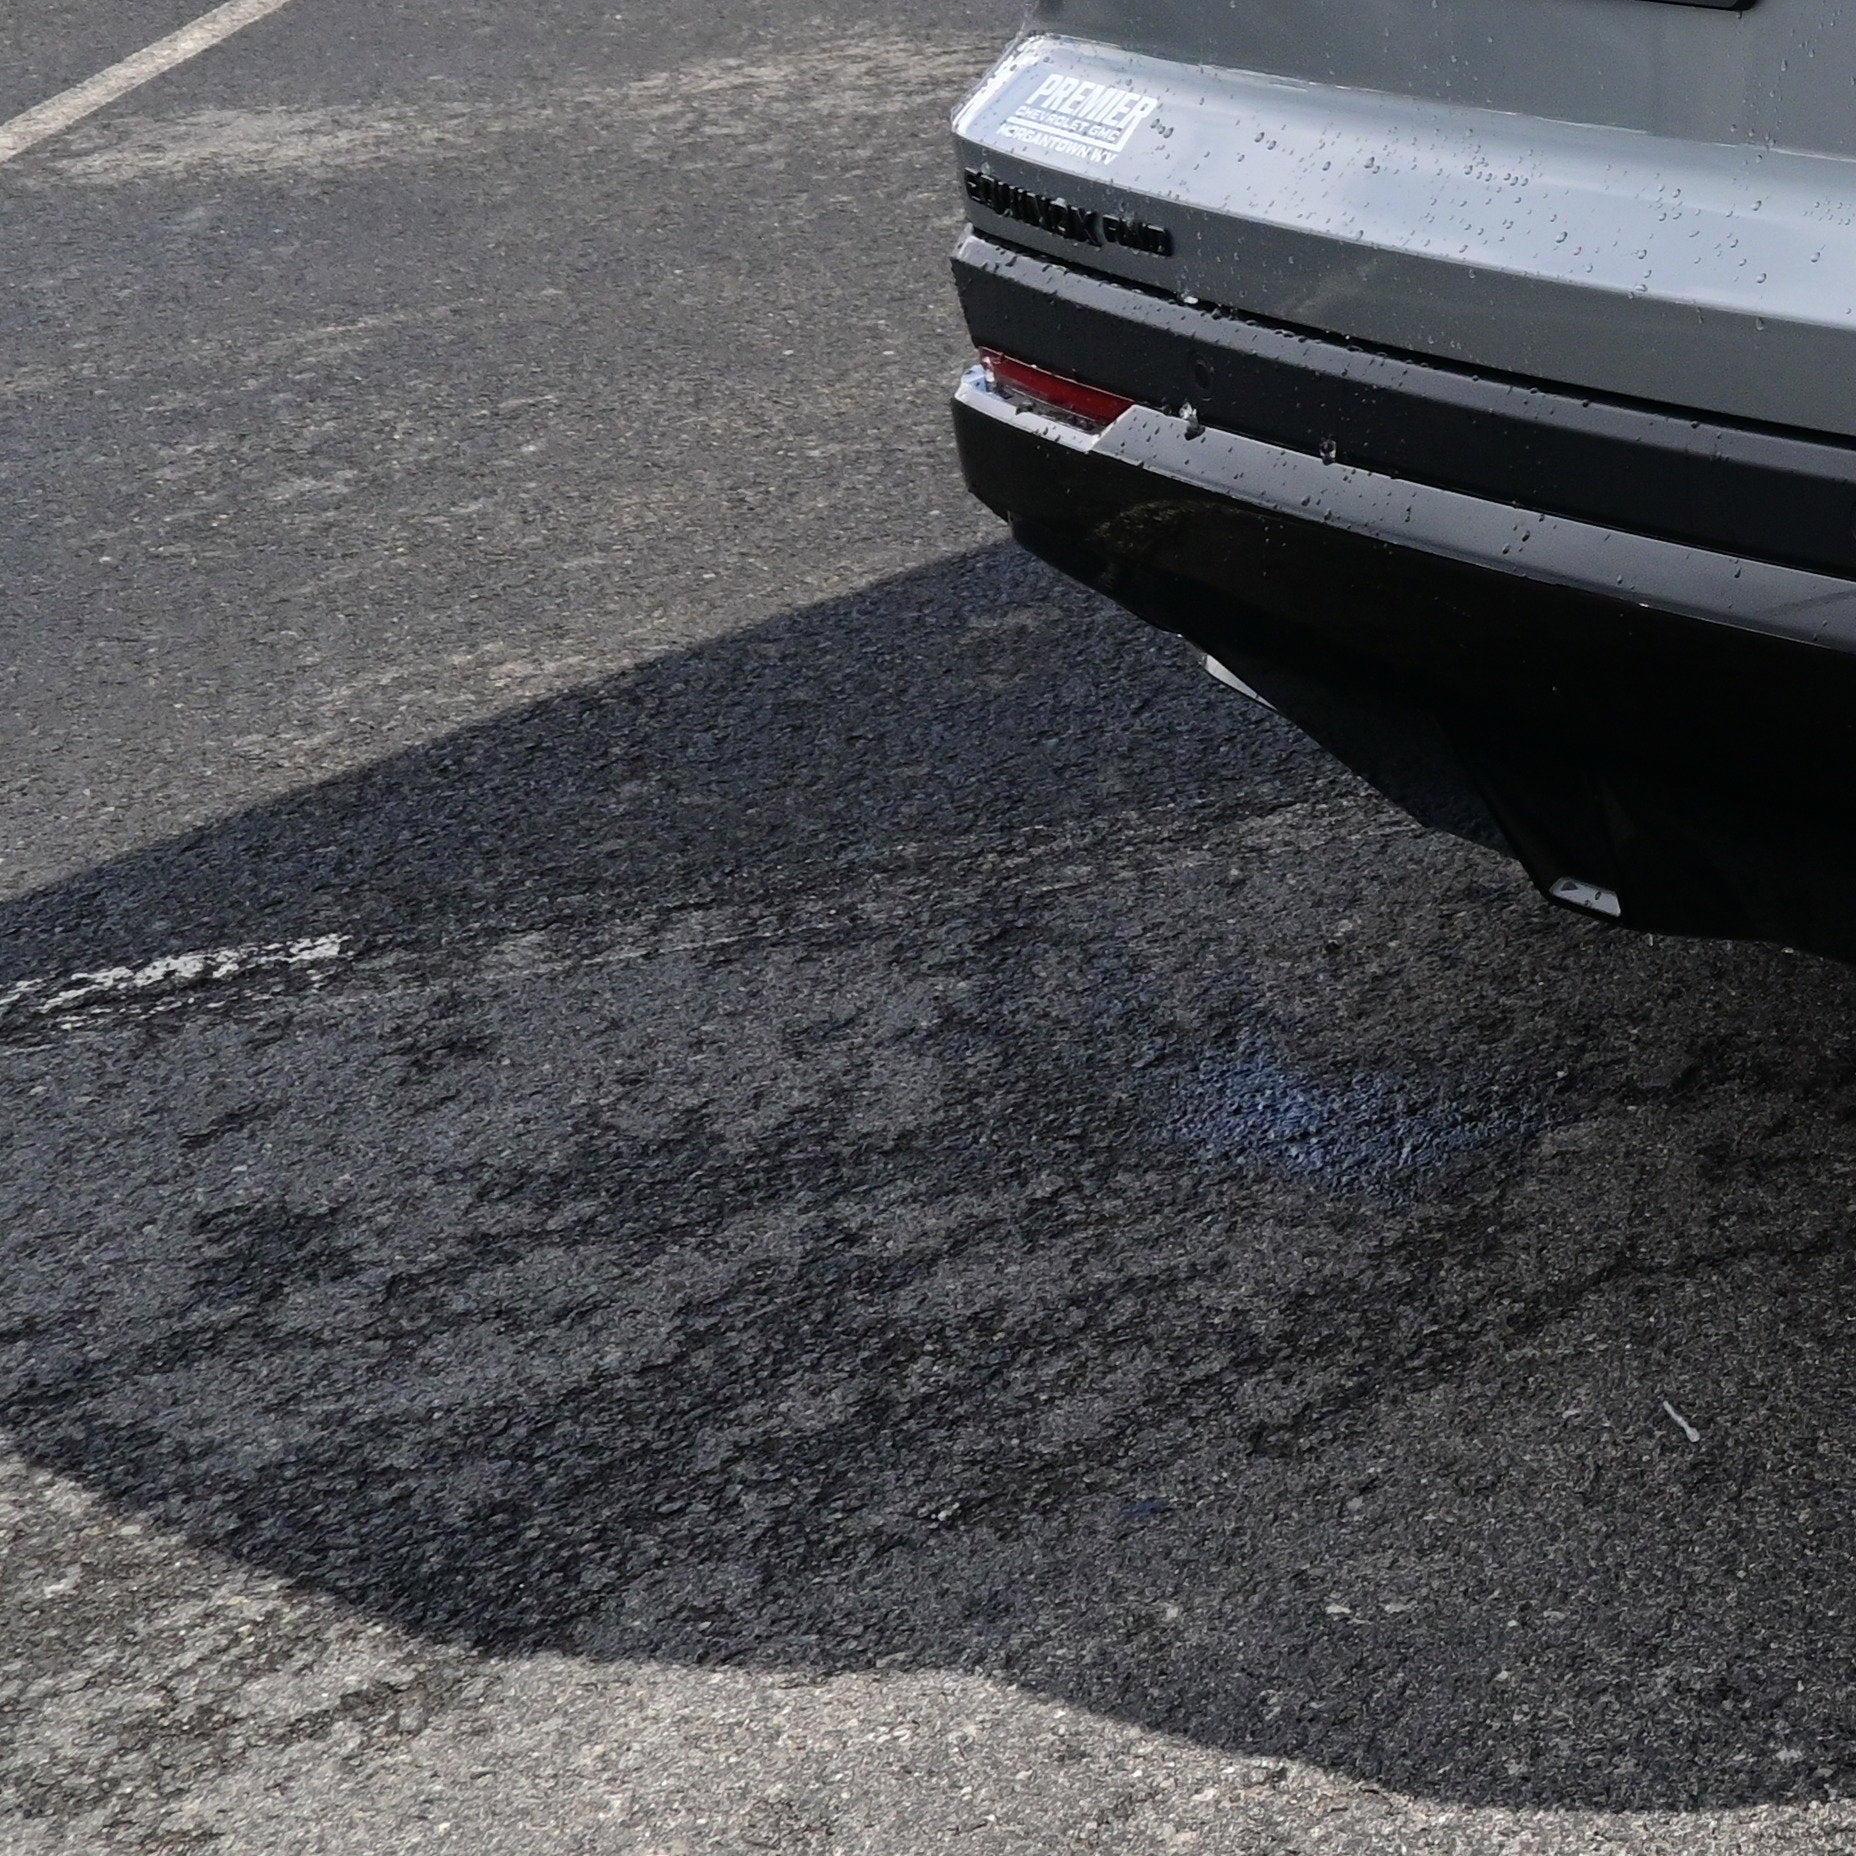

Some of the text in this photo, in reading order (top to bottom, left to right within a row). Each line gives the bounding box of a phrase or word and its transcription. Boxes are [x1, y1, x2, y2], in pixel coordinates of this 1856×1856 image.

[1015, 105, 1121, 144] CHEVROLET GMC
[1025, 73, 1159, 132] PREMIER
[996, 122, 1119, 166] MORGANTOWN WV
